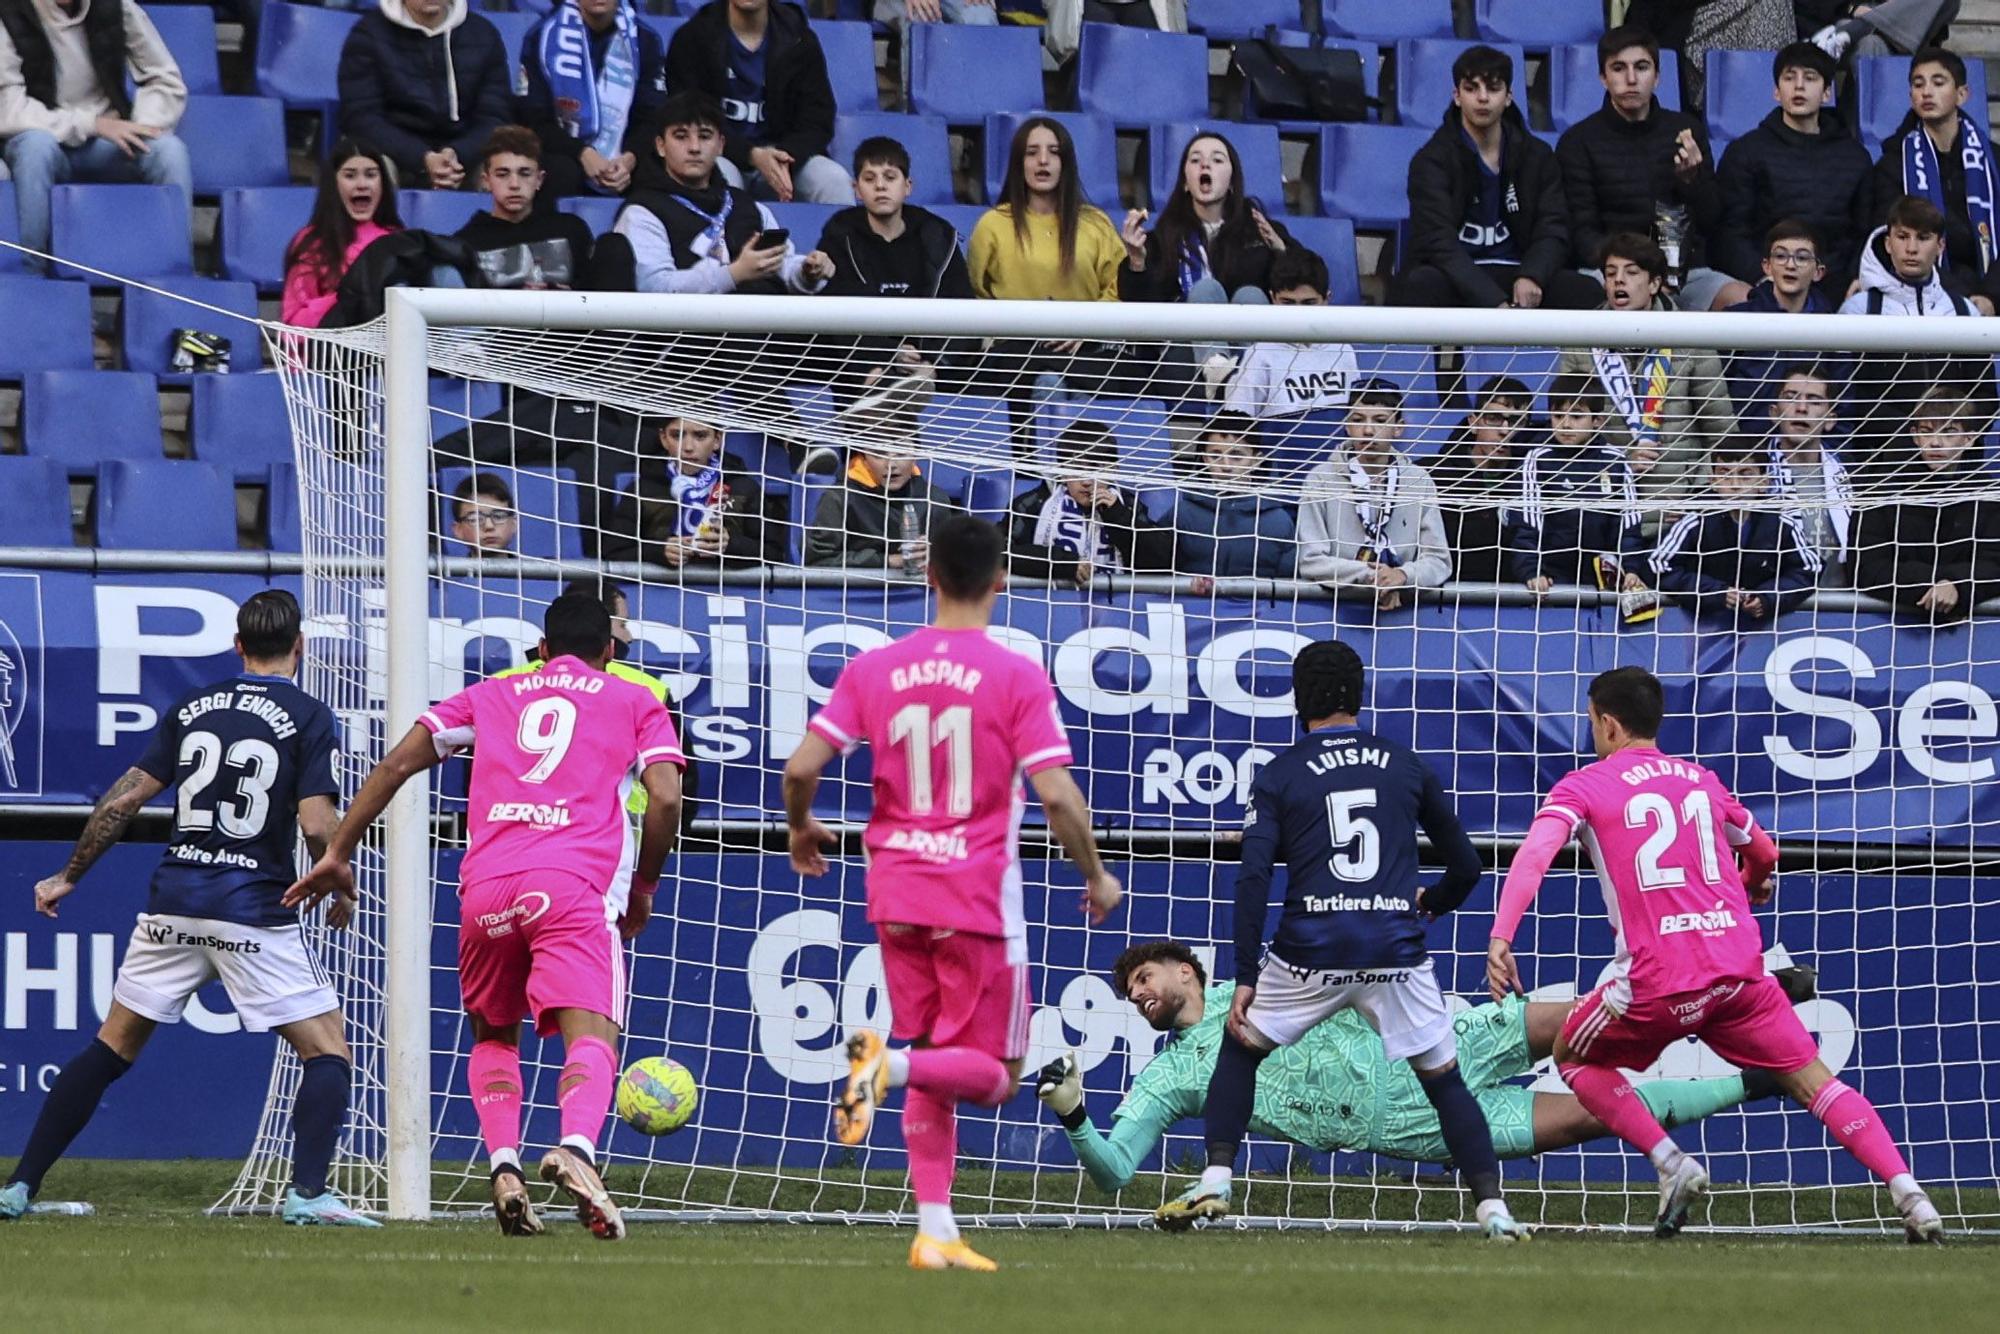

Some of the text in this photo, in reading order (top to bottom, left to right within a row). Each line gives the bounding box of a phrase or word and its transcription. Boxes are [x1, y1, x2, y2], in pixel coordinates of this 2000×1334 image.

[513, 674, 604, 696] MOURAD
[890, 660, 982, 694] GASPAR
[178, 692, 234, 726] SERGI
[235, 694, 298, 740] ENRICH
[1763, 636, 1998, 782] Se
[516, 696, 577, 784] 9
[888, 704, 974, 818] 11
[1306, 748, 1391, 776] LUISMI
[1620, 760, 1701, 786] GOLDAR
[177, 731, 280, 839] 23
[1326, 788, 1379, 882] 5
[1624, 790, 1721, 892] 21
[213, 848, 258, 869] Auto
[1303, 893, 1410, 913] Tartiere Auto
[176, 932, 261, 954] FanSports
[1322, 970, 1410, 986] FanSports
